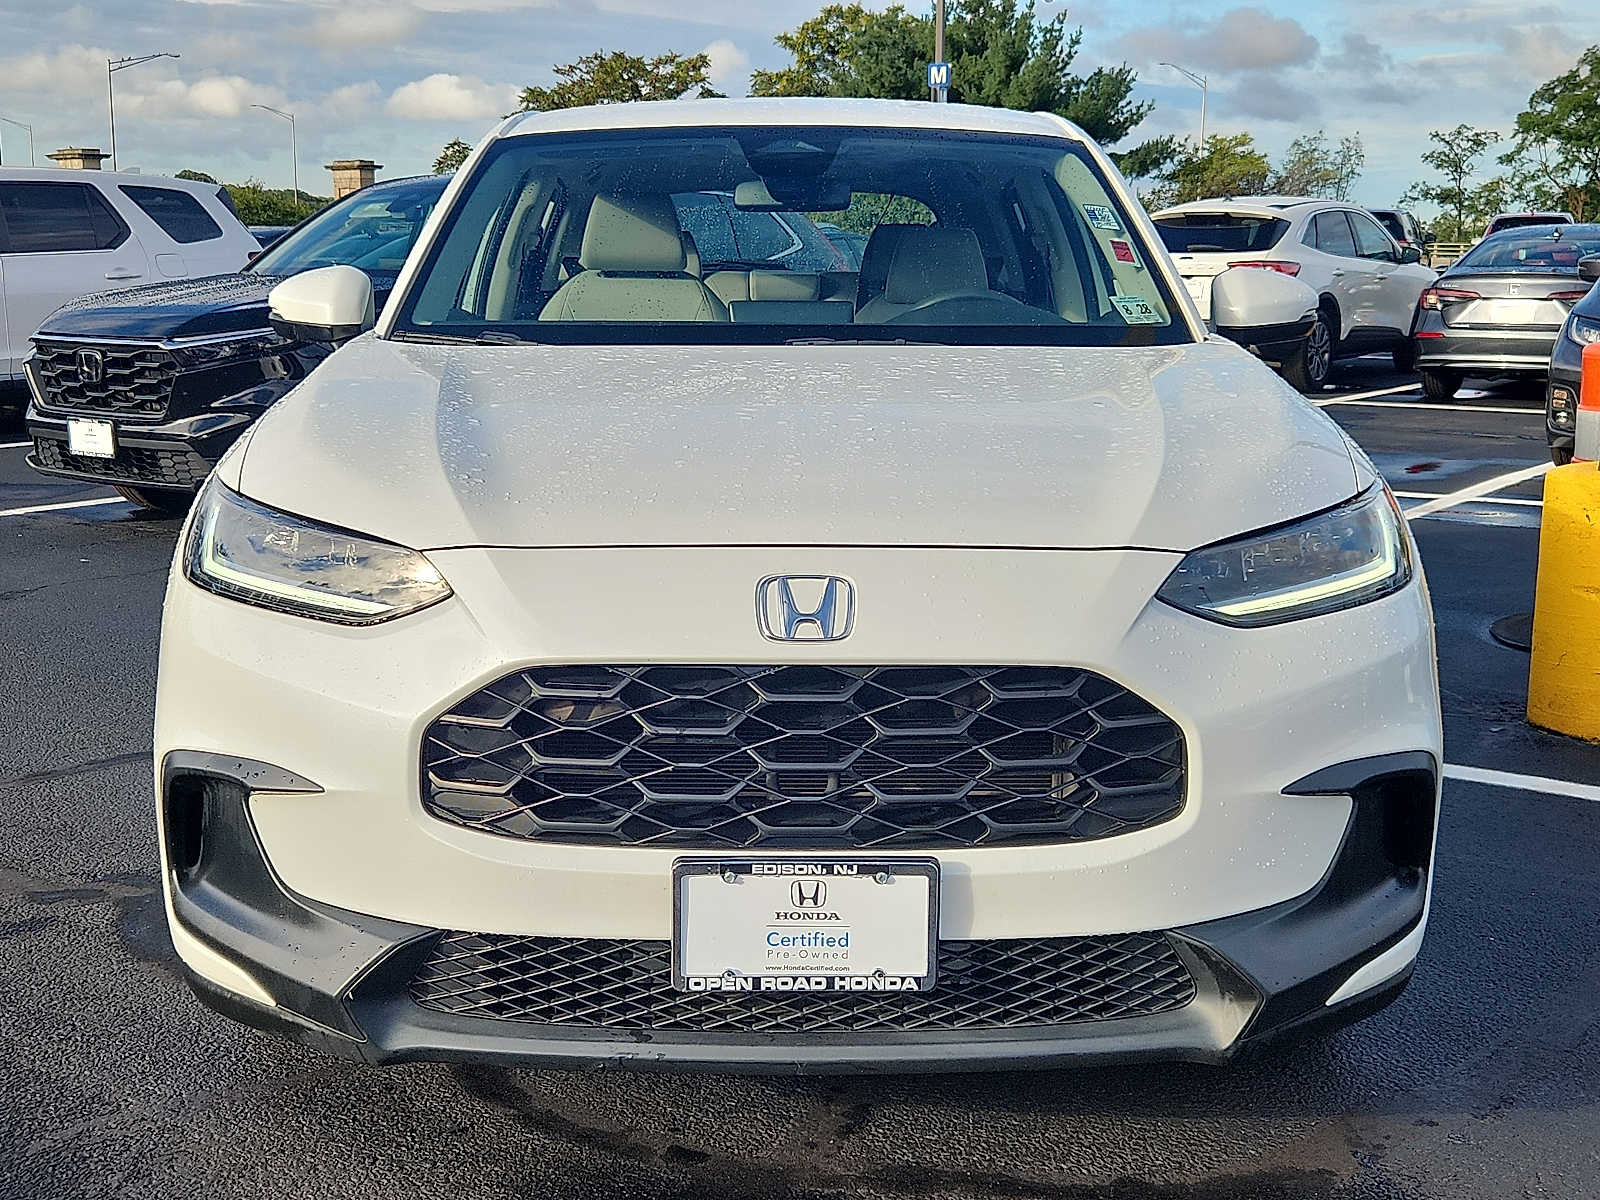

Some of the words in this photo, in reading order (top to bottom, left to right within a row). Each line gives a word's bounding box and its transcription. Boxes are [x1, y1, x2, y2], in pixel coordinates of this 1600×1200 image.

[930, 65, 947, 85] M
[1121, 304, 1133, 315] 8
[1135, 303, 1152, 315] 28
[751, 864, 827, 875] EDISON,
[833, 864, 858, 875] NJ
[774, 911, 842, 921] HONDA
[766, 931, 849, 948] Certified
[767, 949, 849, 960] Pre-Owned
[765, 964, 850, 972] www.HondaCertified.com
[688, 976, 752, 991] OPEN
[760, 976, 827, 991] ROAD
[834, 976, 919, 991] HONDA
